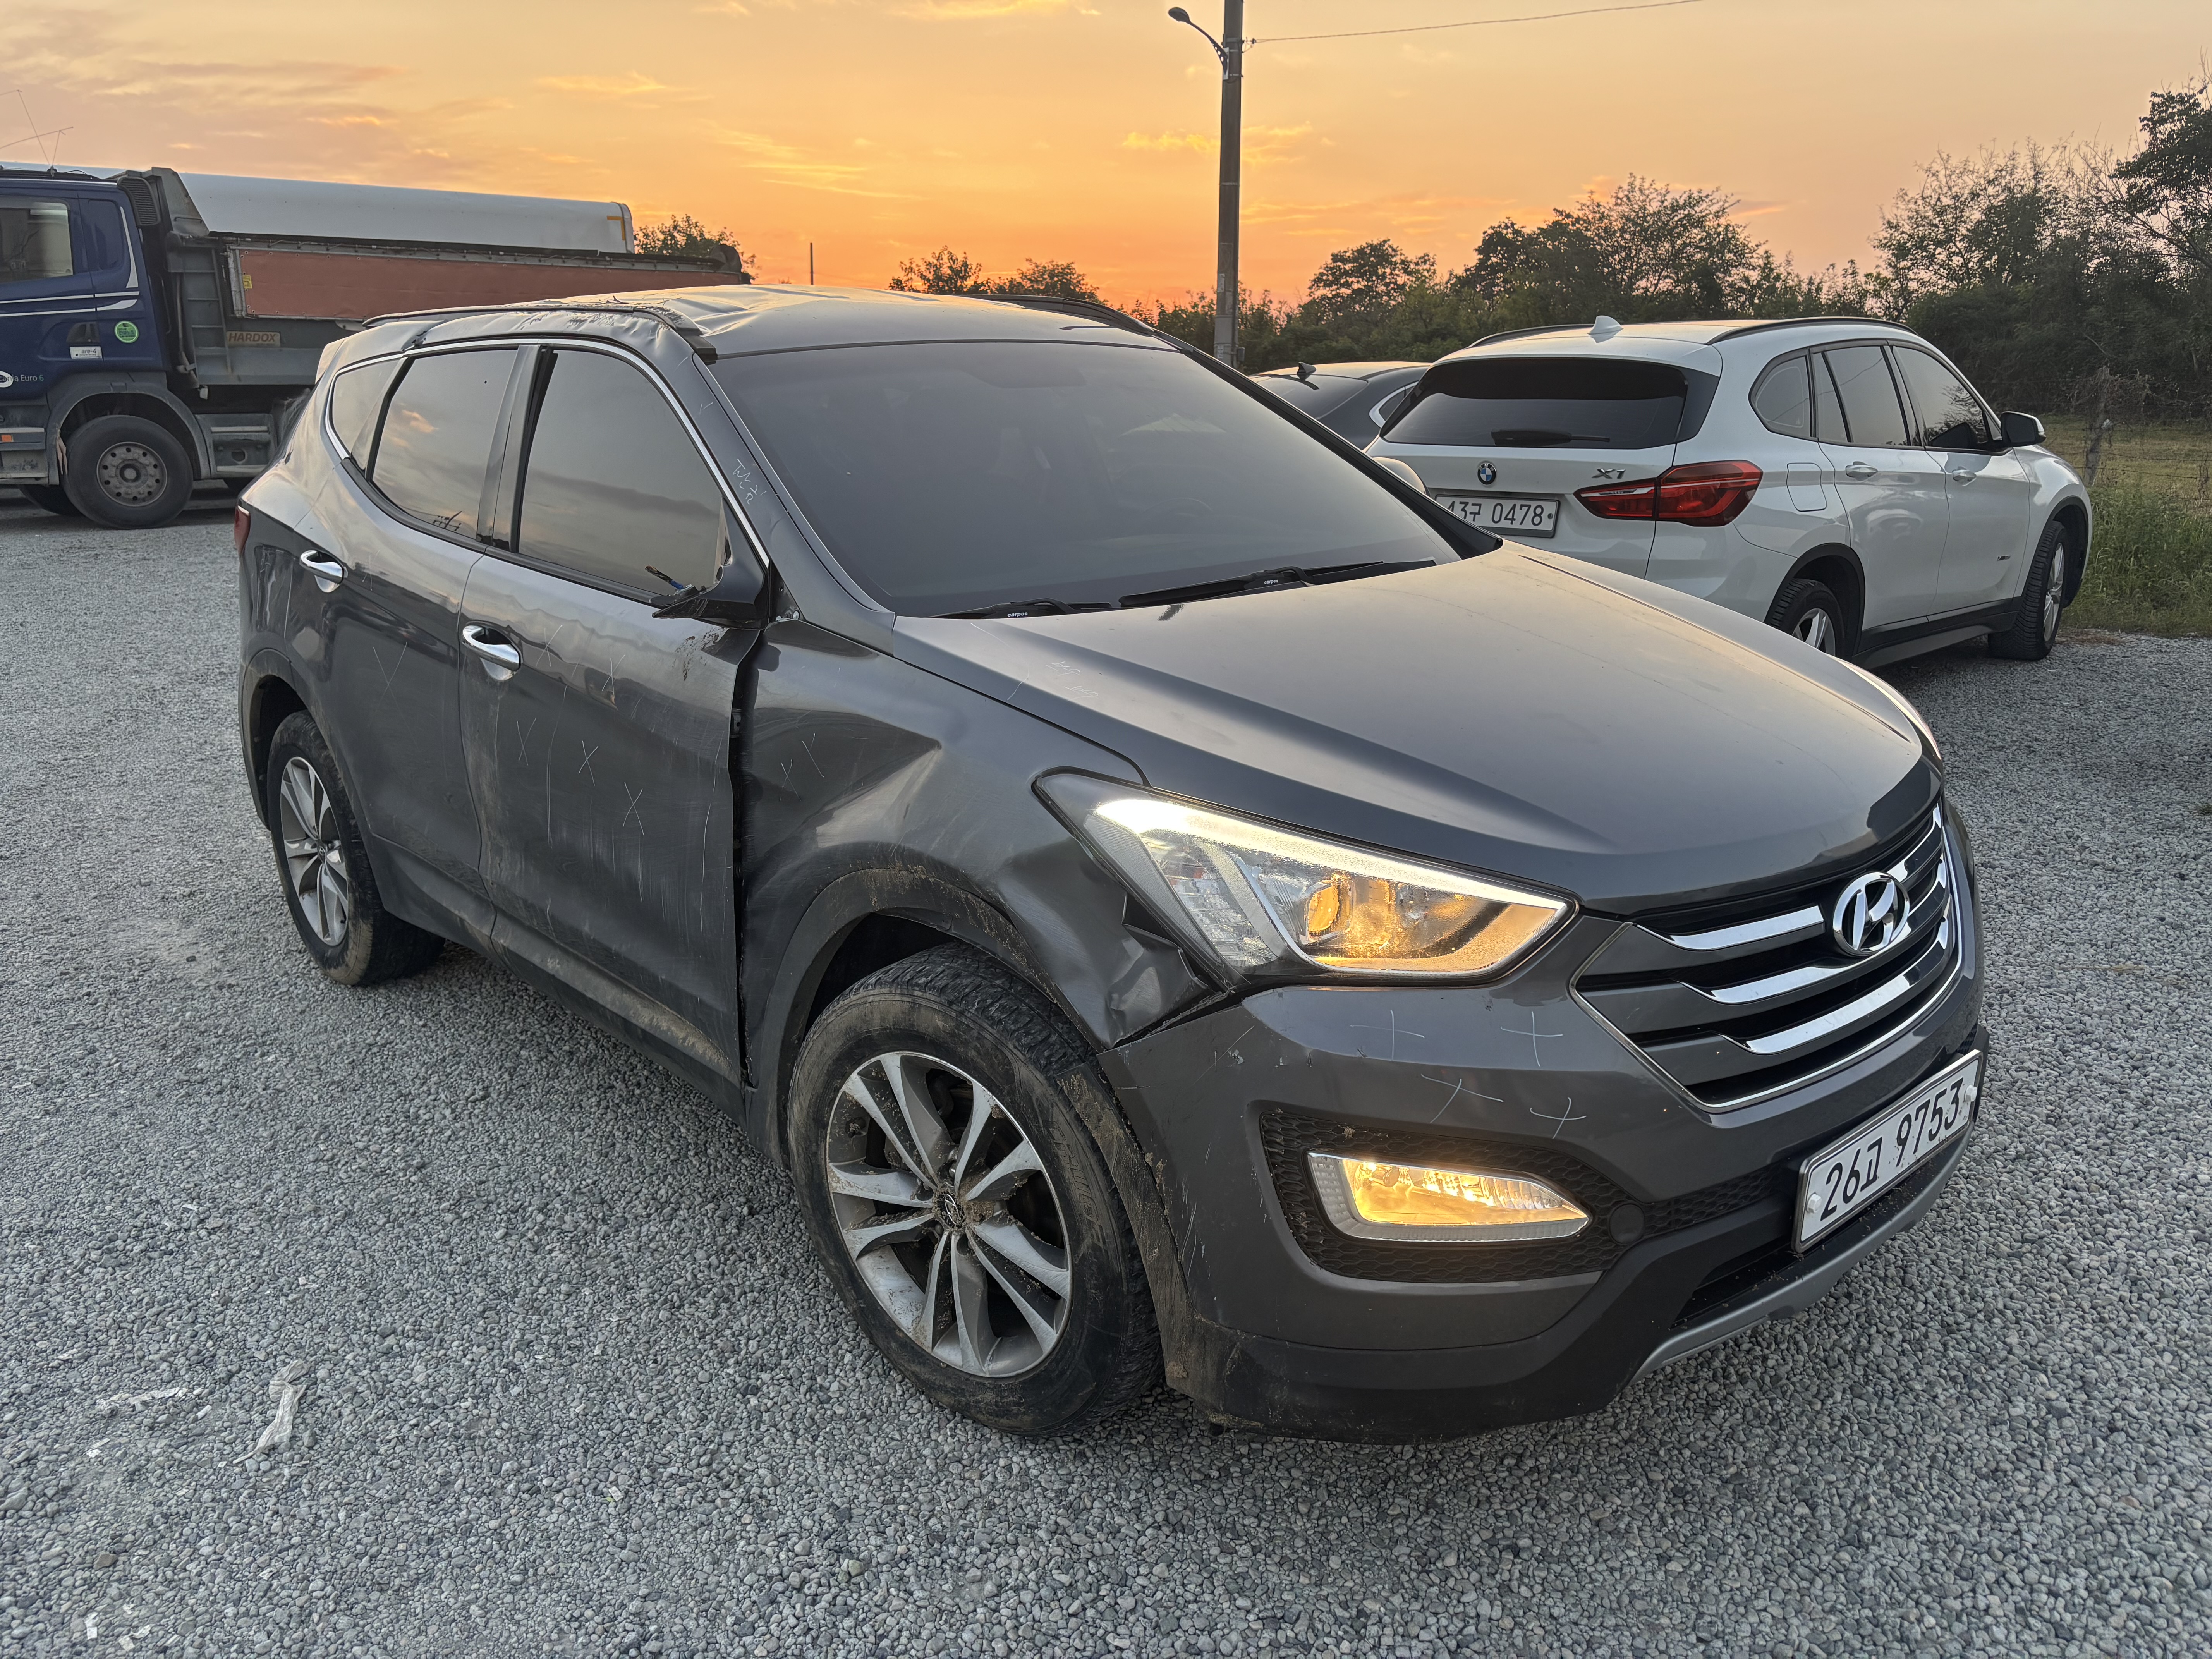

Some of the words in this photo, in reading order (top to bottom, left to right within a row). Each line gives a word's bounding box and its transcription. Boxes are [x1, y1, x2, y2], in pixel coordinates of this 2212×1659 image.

[228, 333, 276, 342] HARDOX
[1592, 469, 1626, 479] X1
[1492, 503, 1544, 526] 0478
[1820, 1136, 1883, 1221] 26고
[1896, 1077, 1964, 1167] 9753
